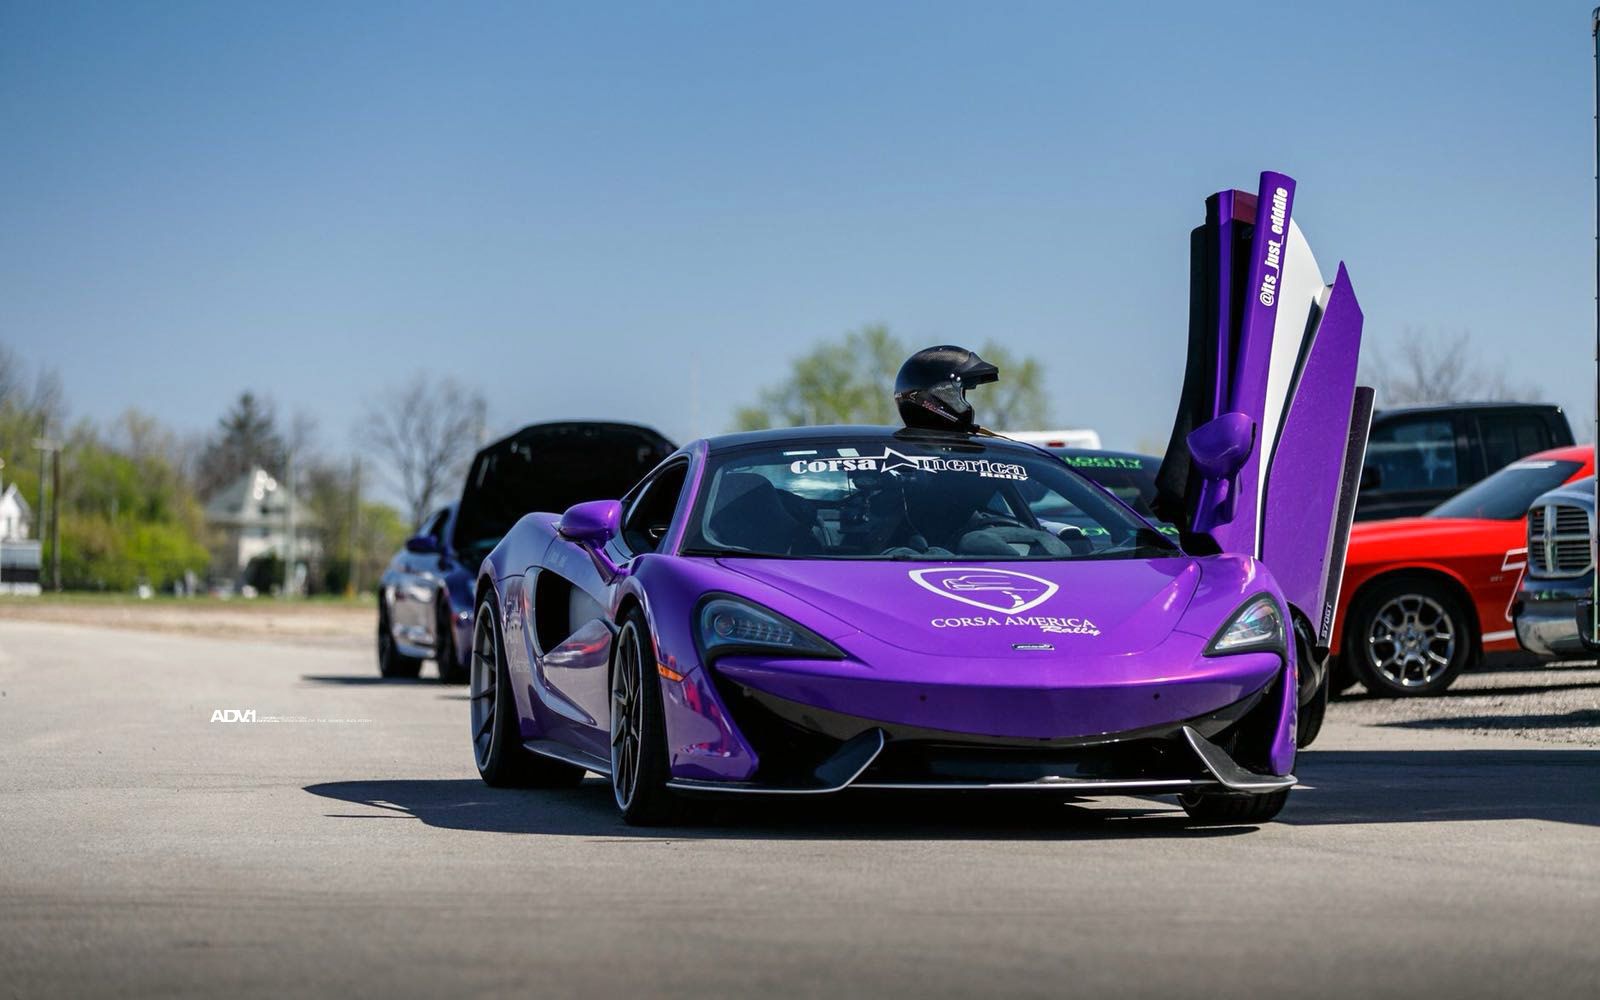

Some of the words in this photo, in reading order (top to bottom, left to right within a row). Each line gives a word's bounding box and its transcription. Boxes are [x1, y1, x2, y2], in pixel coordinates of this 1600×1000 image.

[931, 617, 1000, 628] CORSA
[1005, 617, 1096, 629] AMERICA
[1040, 625, 1101, 636] Rally
